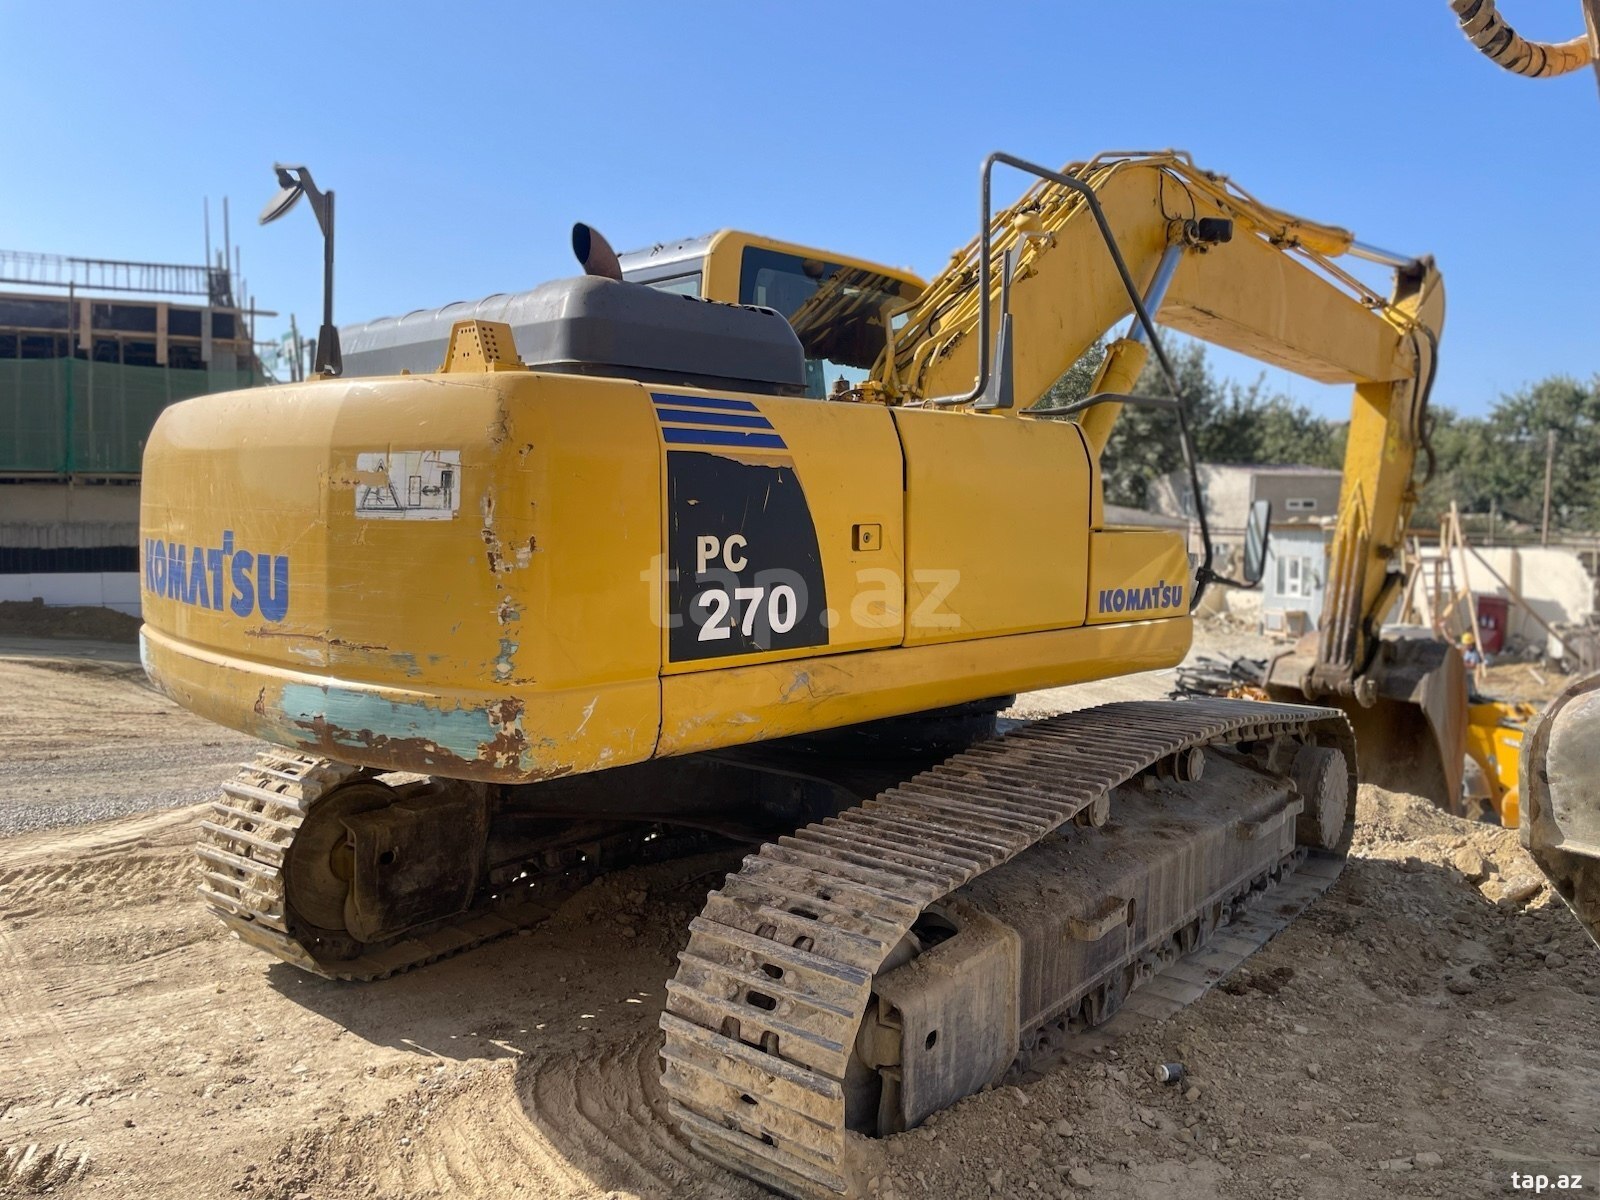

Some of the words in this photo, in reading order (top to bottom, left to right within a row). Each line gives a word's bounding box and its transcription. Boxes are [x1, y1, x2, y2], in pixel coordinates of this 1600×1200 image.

[145, 530, 290, 623] KOMATSU
[696, 534, 748, 574] PC
[697, 585, 797, 641] 270
[1099, 580, 1183, 613] KOMATSU
